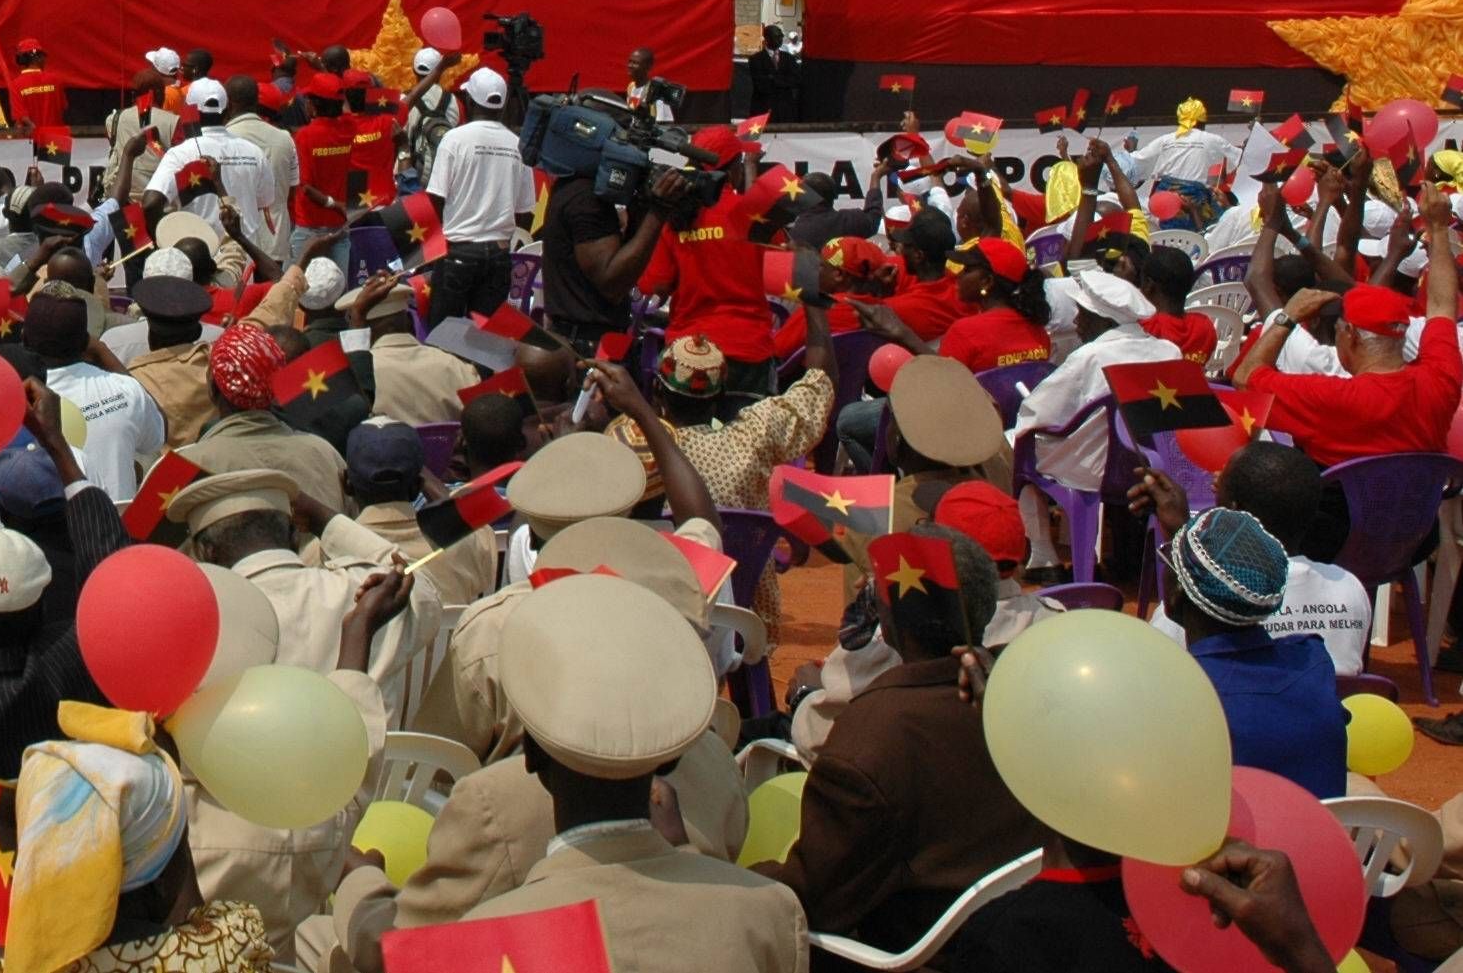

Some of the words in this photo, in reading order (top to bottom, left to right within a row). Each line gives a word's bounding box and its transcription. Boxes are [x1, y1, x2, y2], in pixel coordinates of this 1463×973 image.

[1302, 604, 1348, 614] ANGOLA
[1265, 622, 1294, 633] UDAR
[1297, 620, 1326, 630] PARA
